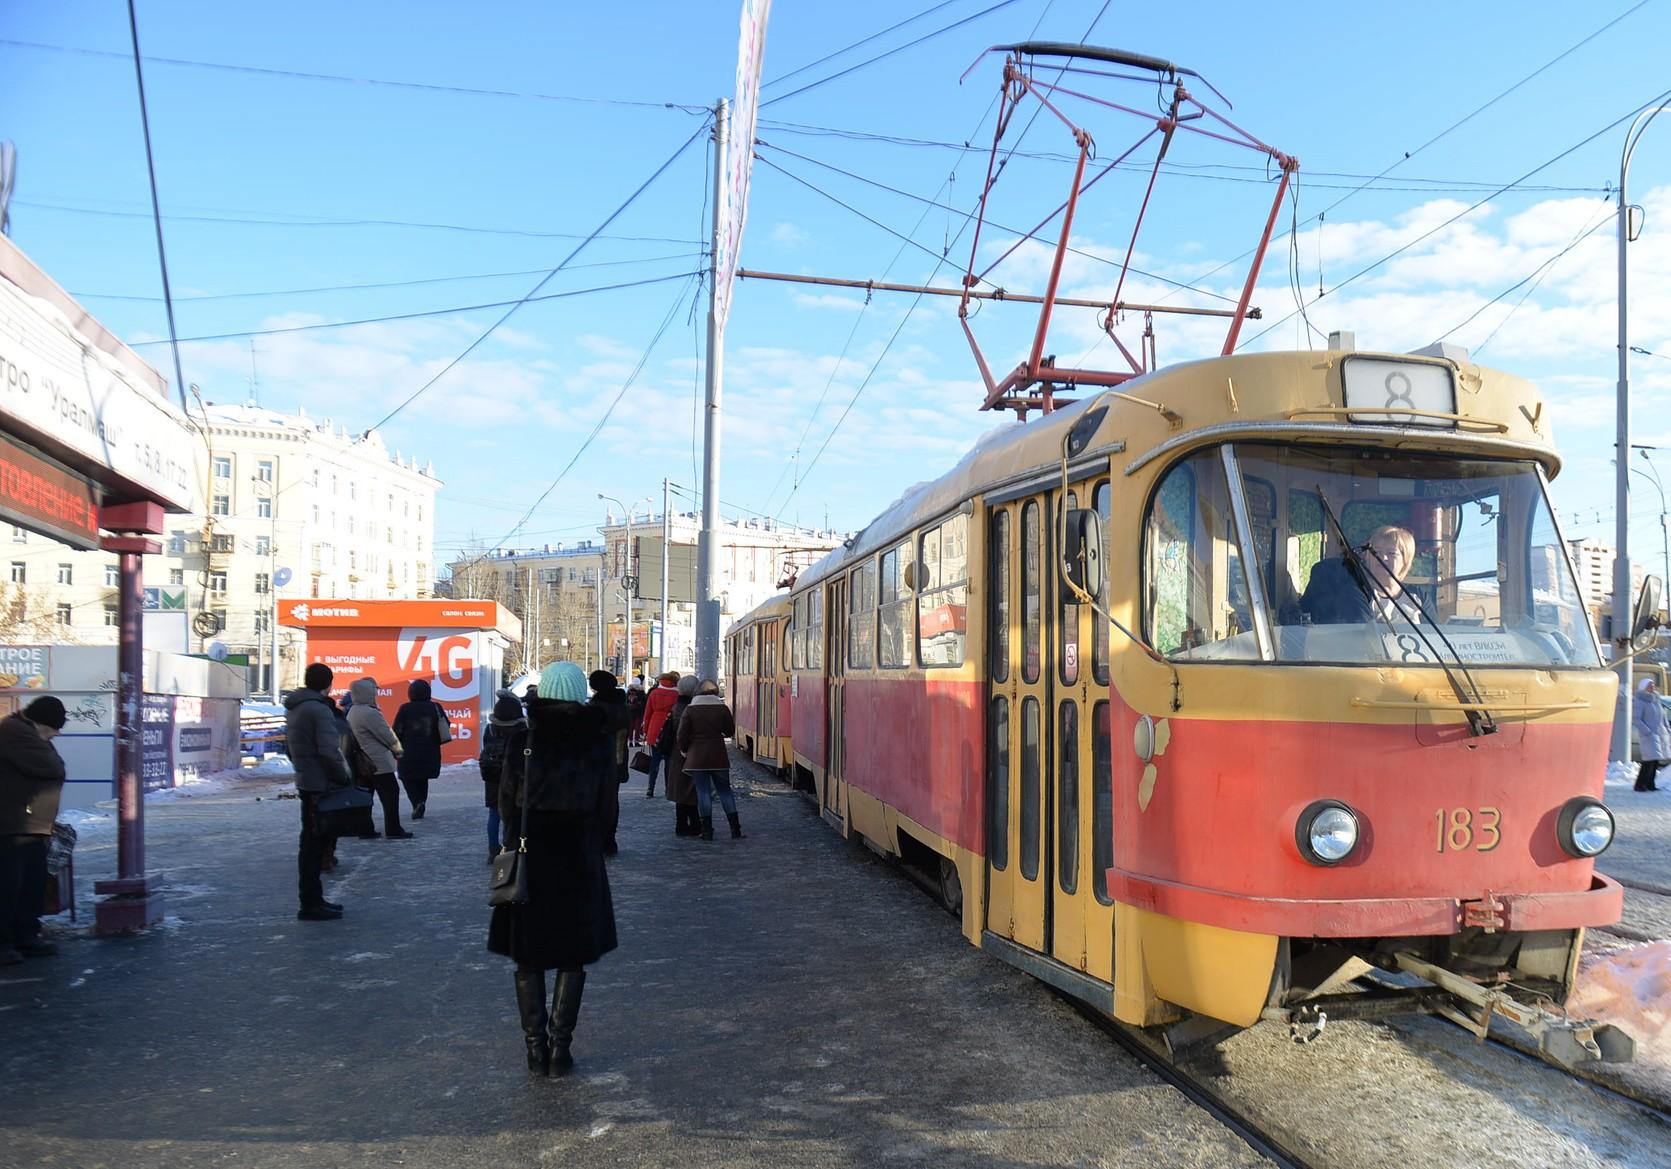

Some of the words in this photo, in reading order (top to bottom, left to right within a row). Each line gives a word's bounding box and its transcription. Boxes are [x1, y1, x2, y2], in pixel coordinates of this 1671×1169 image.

[1384, 371, 1416, 423] 8
[325, 656, 376, 664] ВЫГОДНЫЕ
[400, 635, 473, 690] 4G
[1397, 634, 1429, 663] 8
[329, 665, 363, 674] АРИФЫ
[1436, 806, 1501, 853] 183
